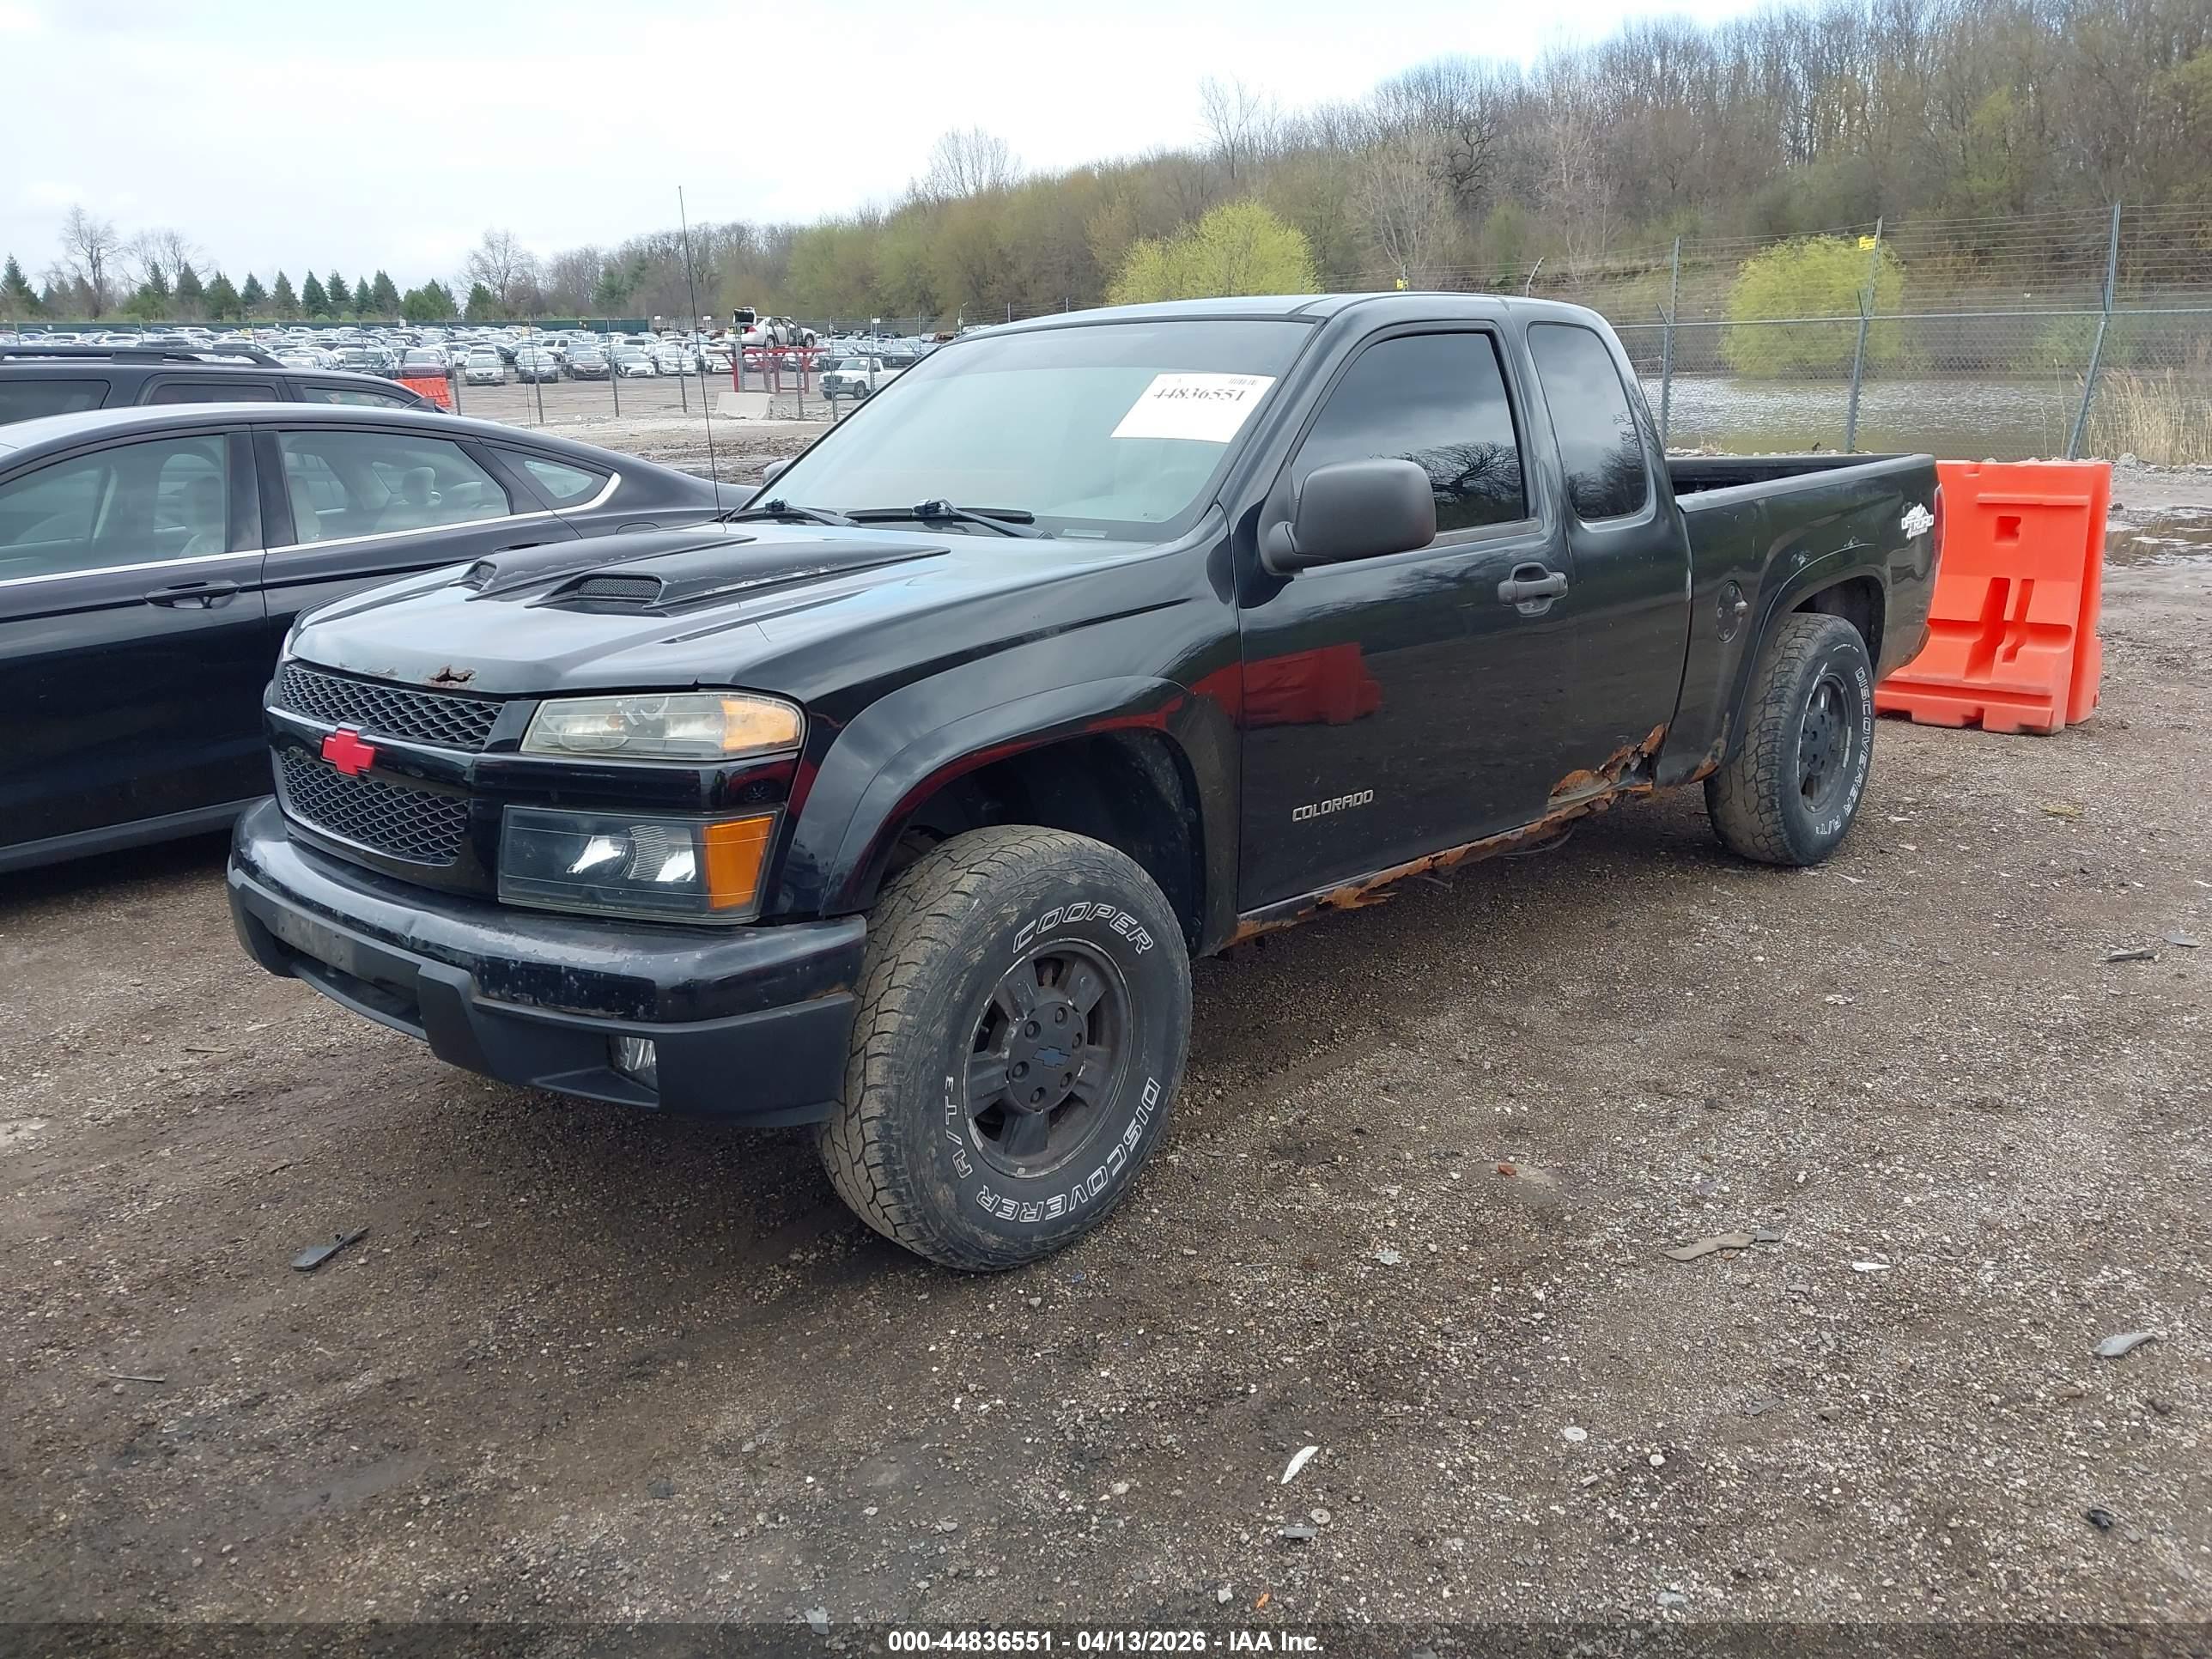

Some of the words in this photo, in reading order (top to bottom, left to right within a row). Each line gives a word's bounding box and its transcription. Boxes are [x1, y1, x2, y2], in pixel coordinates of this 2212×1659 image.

[1152, 386, 1246, 402] 44836551
[1843, 665, 1873, 817] DISCOVERER
[1291, 789, 1374, 823] COLORADO
[1012, 901, 1155, 956] COOPER
[975, 1076, 1162, 1224] DISCOVERER
